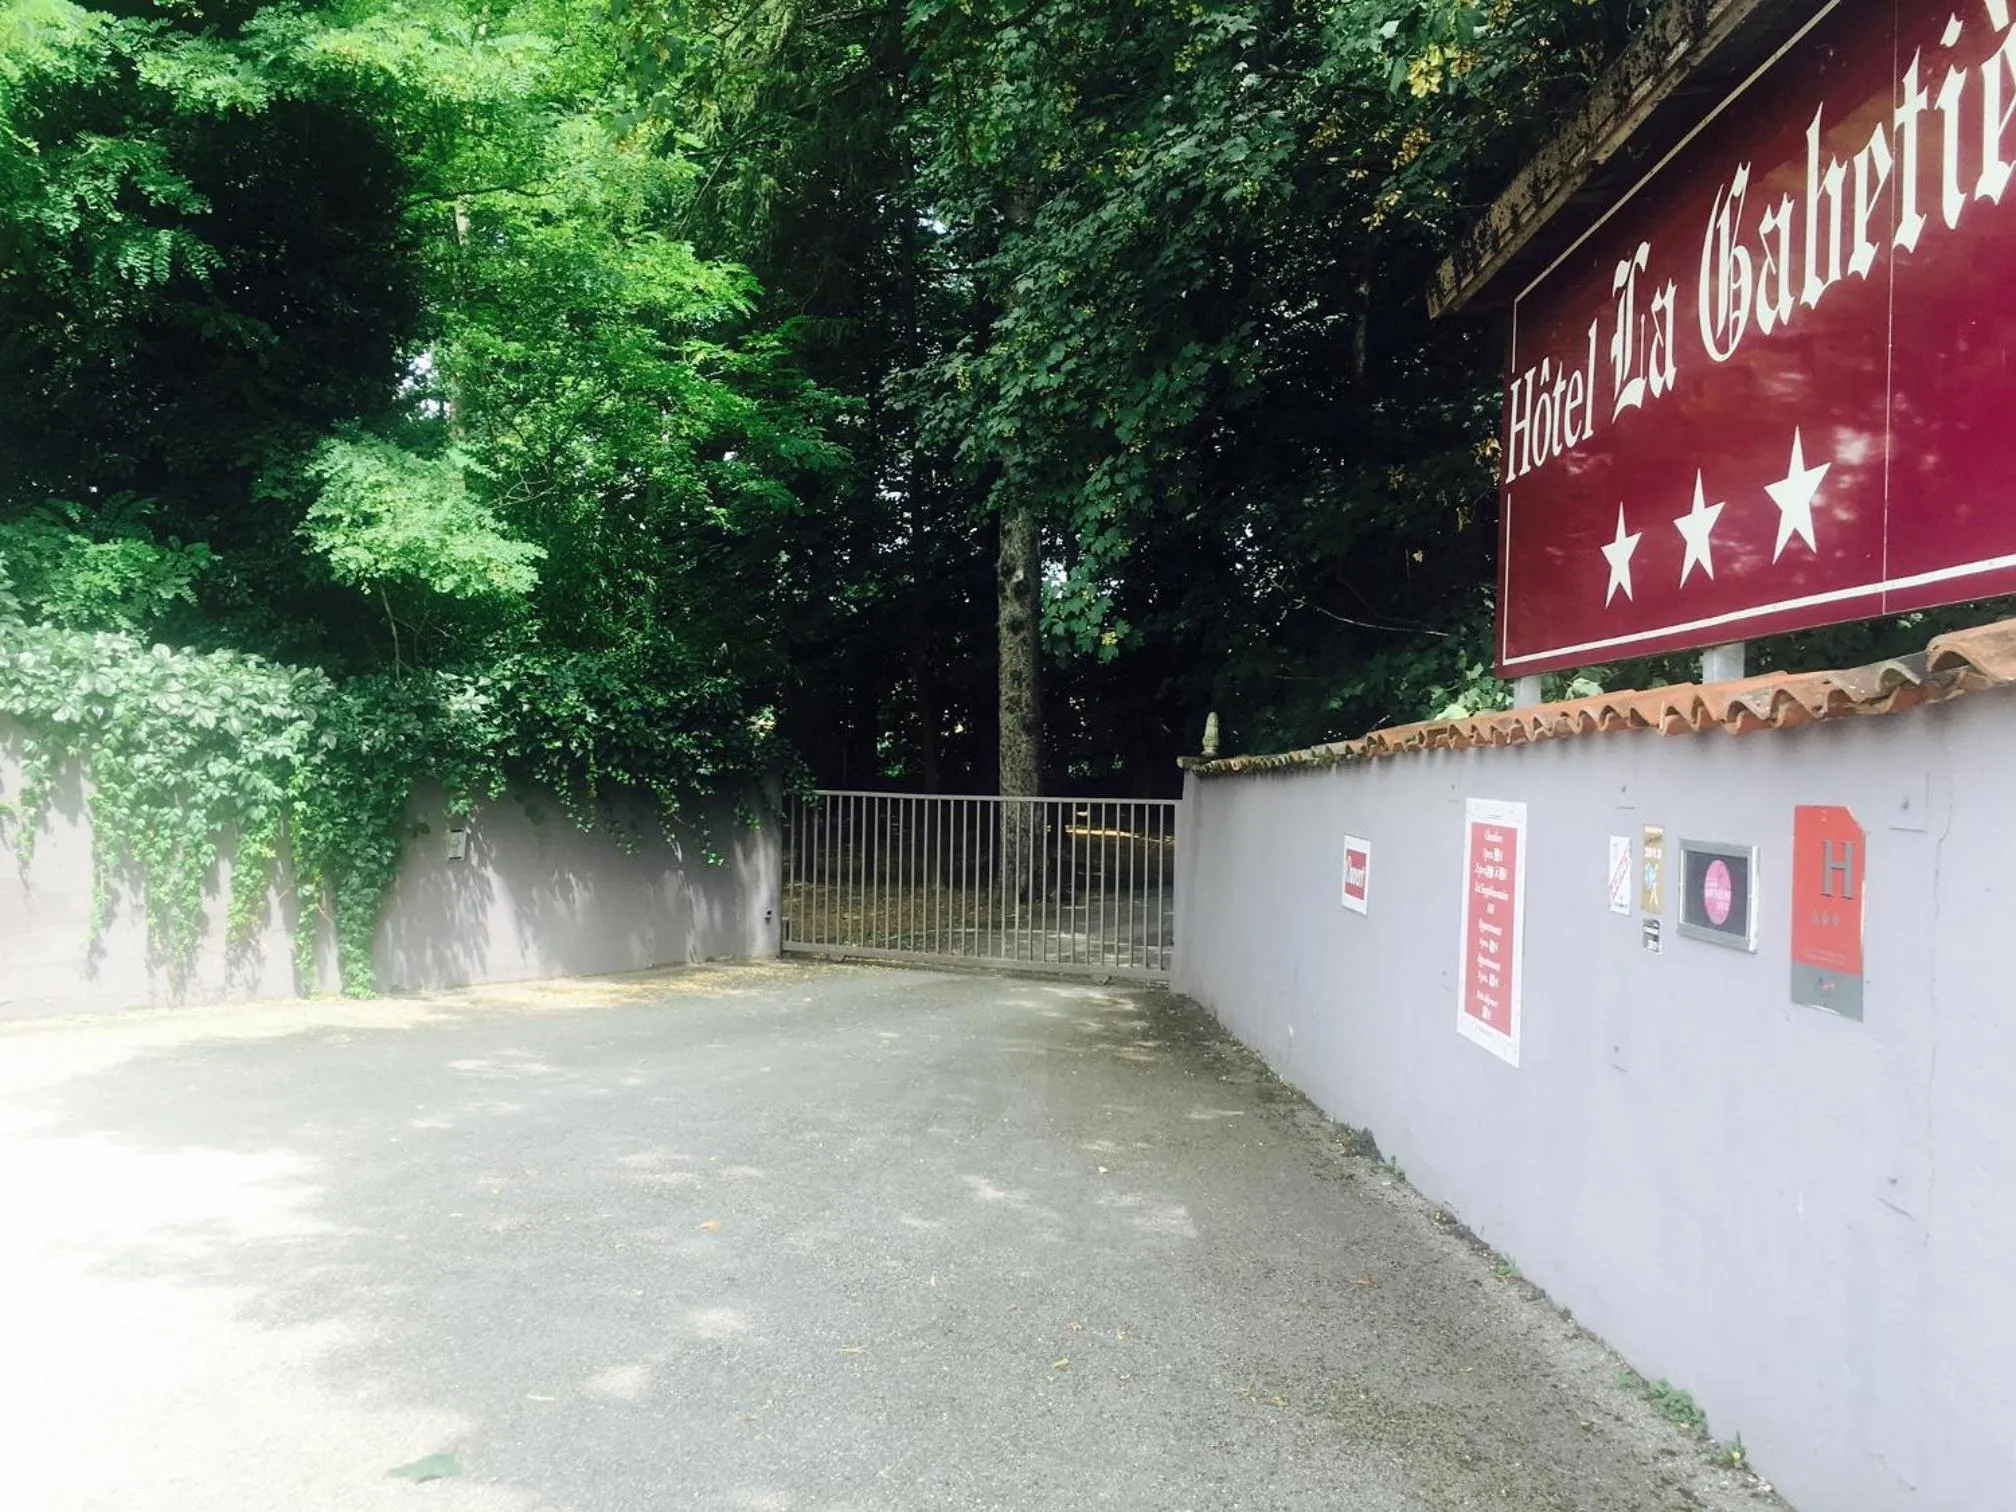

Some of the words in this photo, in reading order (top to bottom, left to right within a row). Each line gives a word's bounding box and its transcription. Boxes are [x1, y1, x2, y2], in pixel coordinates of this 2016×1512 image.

[1505, 316, 1598, 483] Hôtel
[1610, 240, 1678, 425] La
[1822, 839, 1856, 900] H
